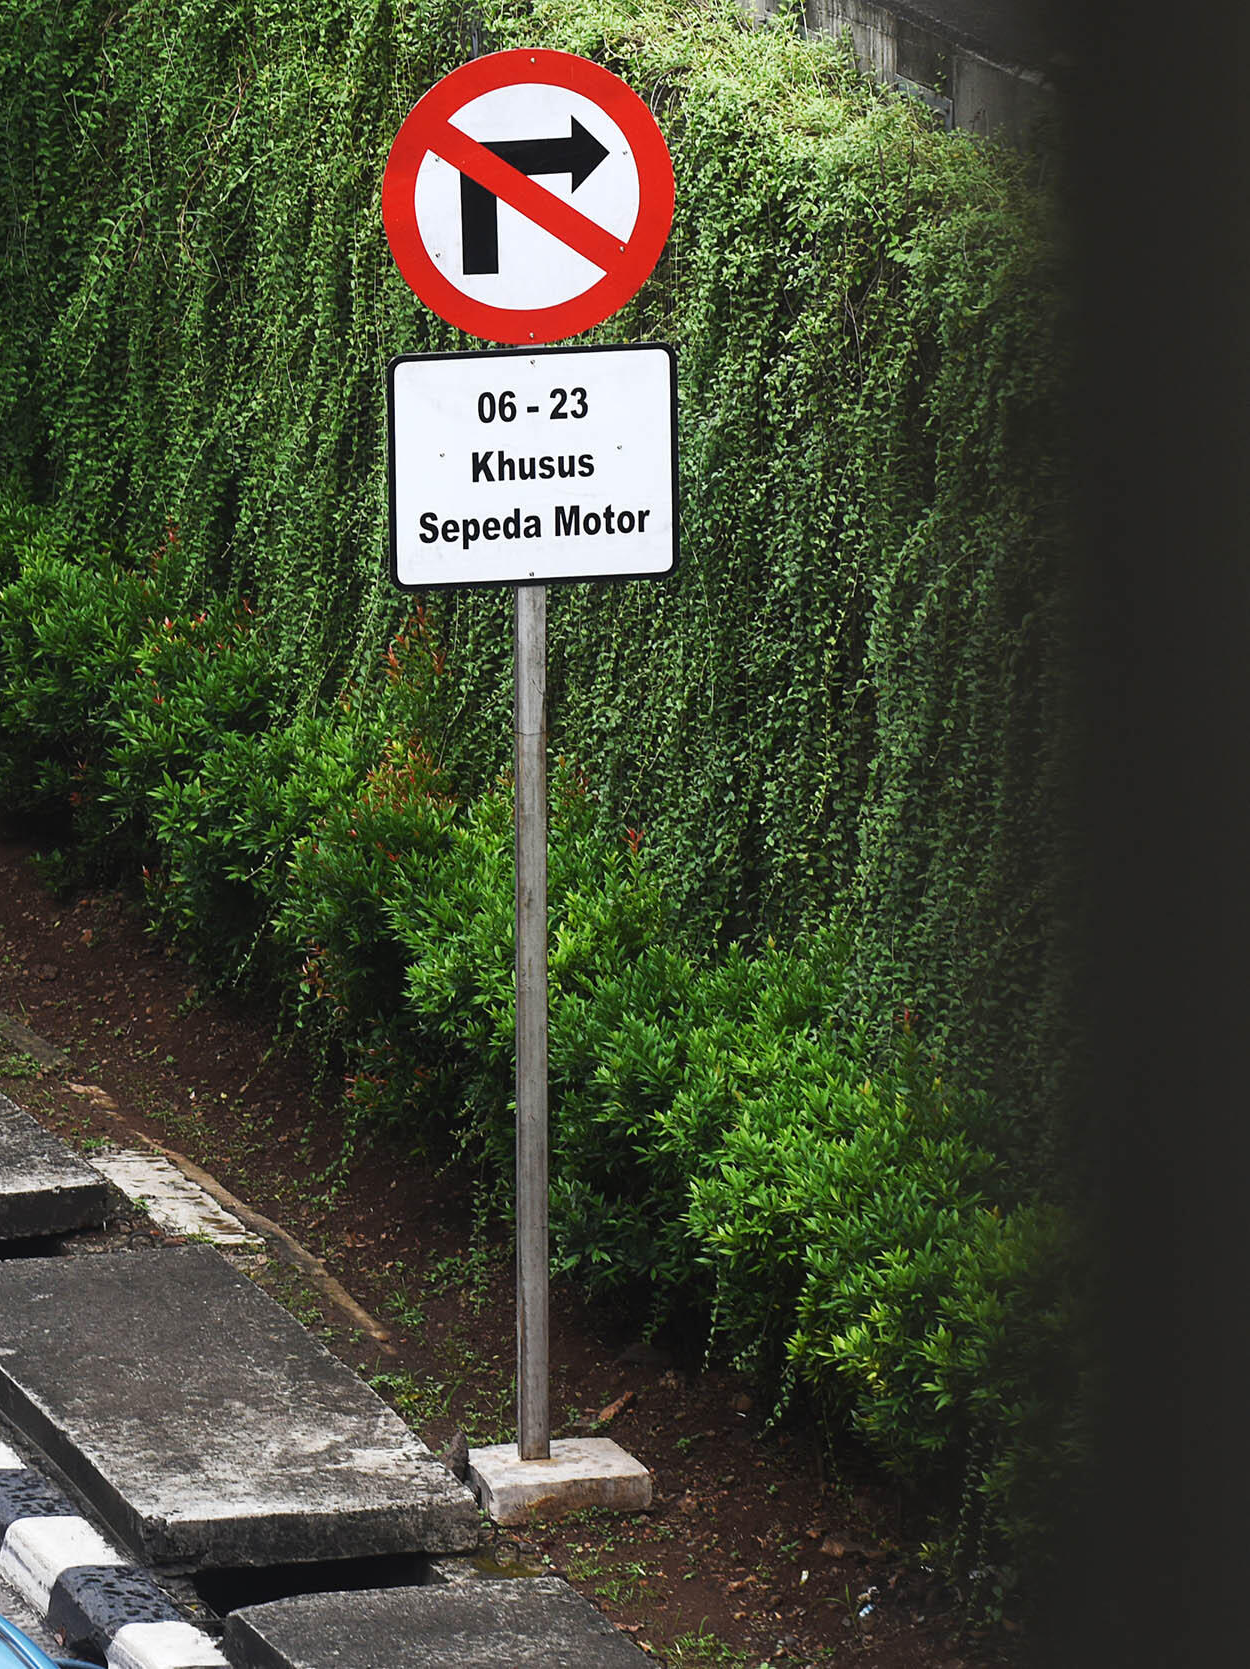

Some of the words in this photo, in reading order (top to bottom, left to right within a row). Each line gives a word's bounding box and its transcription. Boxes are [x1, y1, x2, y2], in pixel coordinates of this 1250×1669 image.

[477, 390, 517, 424] 06
[549, 387, 589, 420] 23
[471, 450, 595, 483] Khusus
[419, 508, 542, 550] Sepeda
[554, 504, 650, 537] Motor
